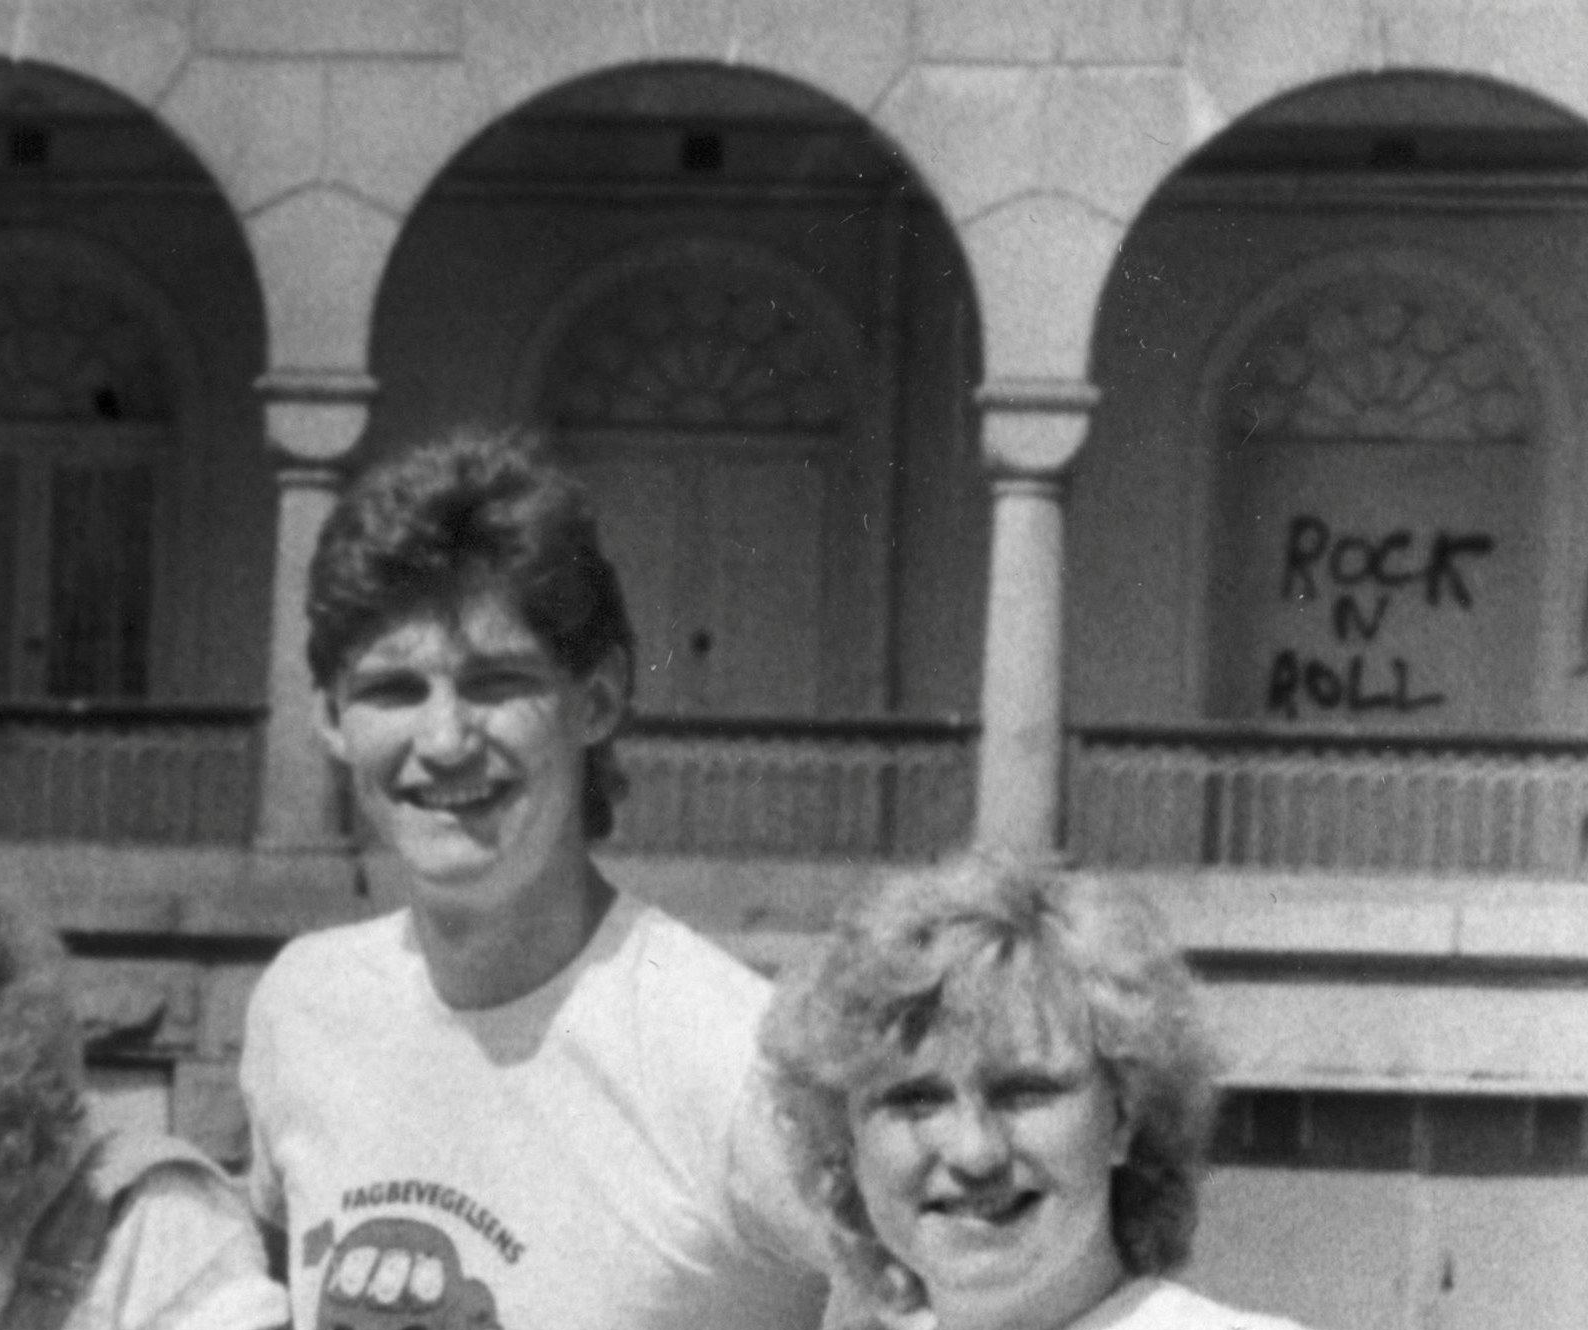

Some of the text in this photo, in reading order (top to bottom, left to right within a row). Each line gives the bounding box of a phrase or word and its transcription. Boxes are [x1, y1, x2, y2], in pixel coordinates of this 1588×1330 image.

[1281, 513, 1494, 612] ROCK
[1332, 593, 1388, 642] N
[1266, 648, 1446, 720] ROLL
[341, 1178, 527, 1267] FAGBEVEGELSENS
